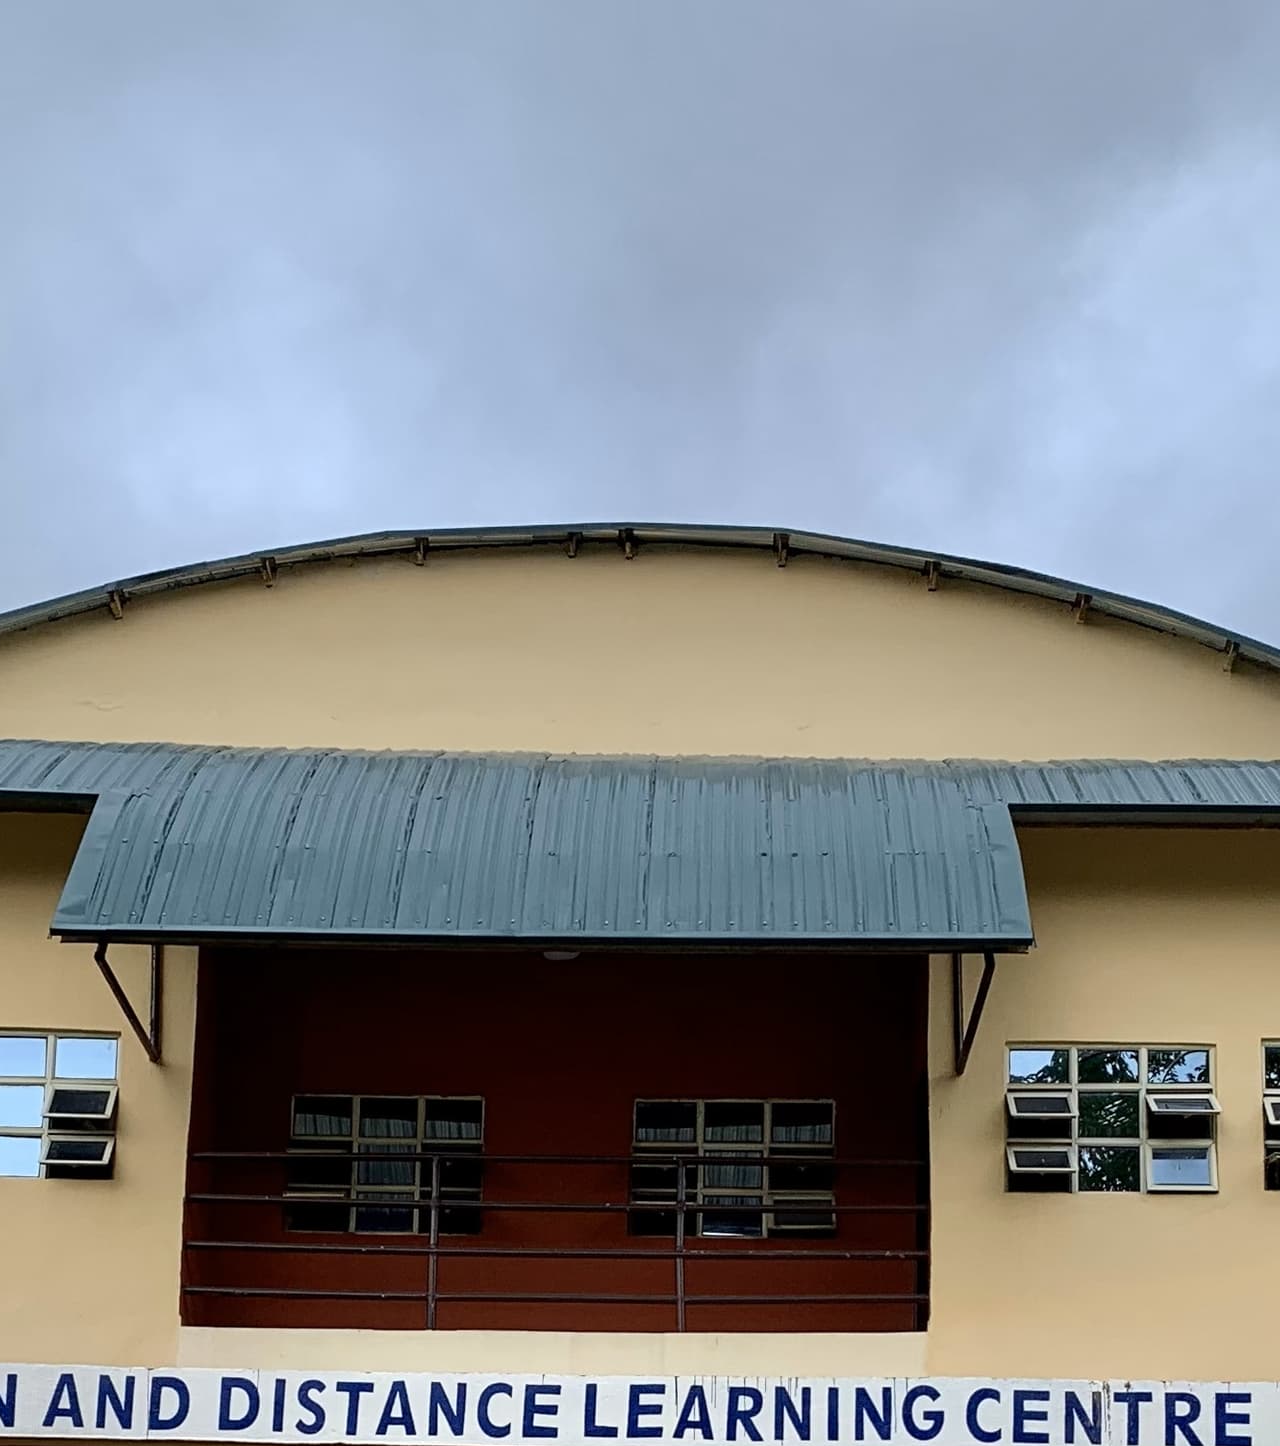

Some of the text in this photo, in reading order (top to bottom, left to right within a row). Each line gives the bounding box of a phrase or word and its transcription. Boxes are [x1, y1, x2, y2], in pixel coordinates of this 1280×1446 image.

[42, 1373, 191, 1431] AND
[218, 1376, 562, 1440] DISTANCE
[583, 1383, 945, 1443] LEARNING
